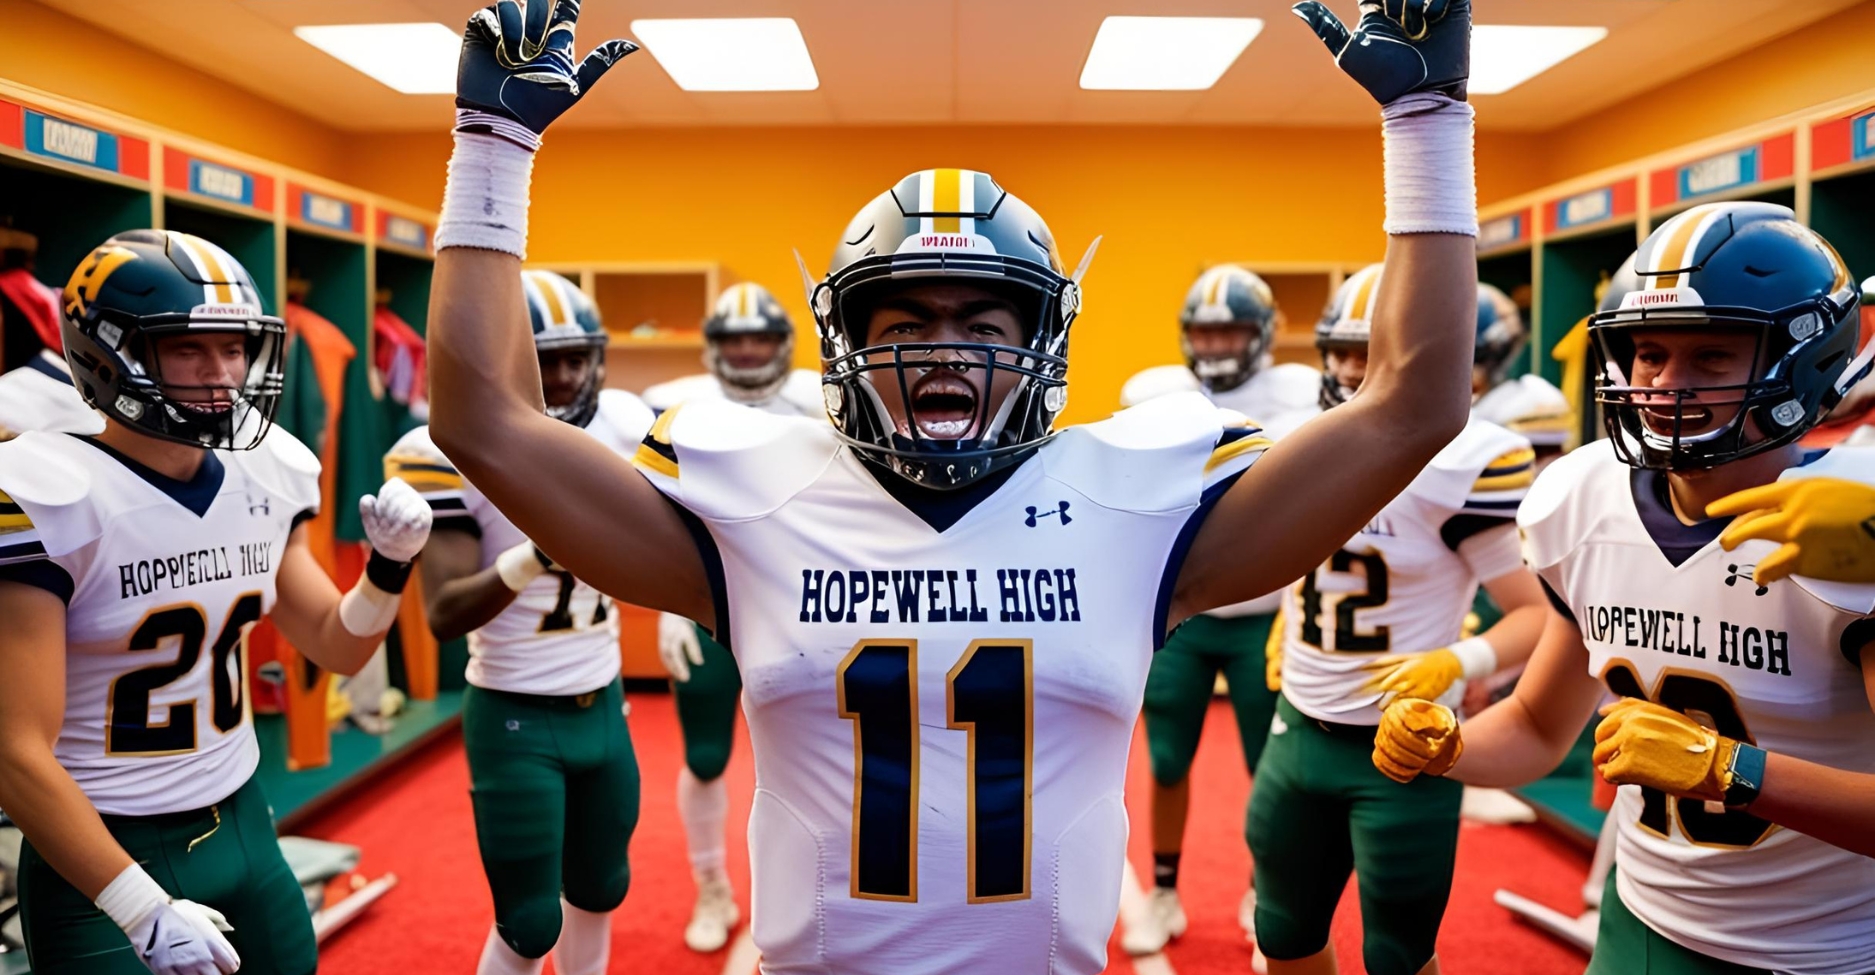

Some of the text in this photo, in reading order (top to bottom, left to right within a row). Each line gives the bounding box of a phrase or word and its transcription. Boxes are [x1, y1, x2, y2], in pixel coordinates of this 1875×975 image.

[799, 567, 1081, 623] HOPEWELL HIGH
[836, 638, 1034, 905] 11
